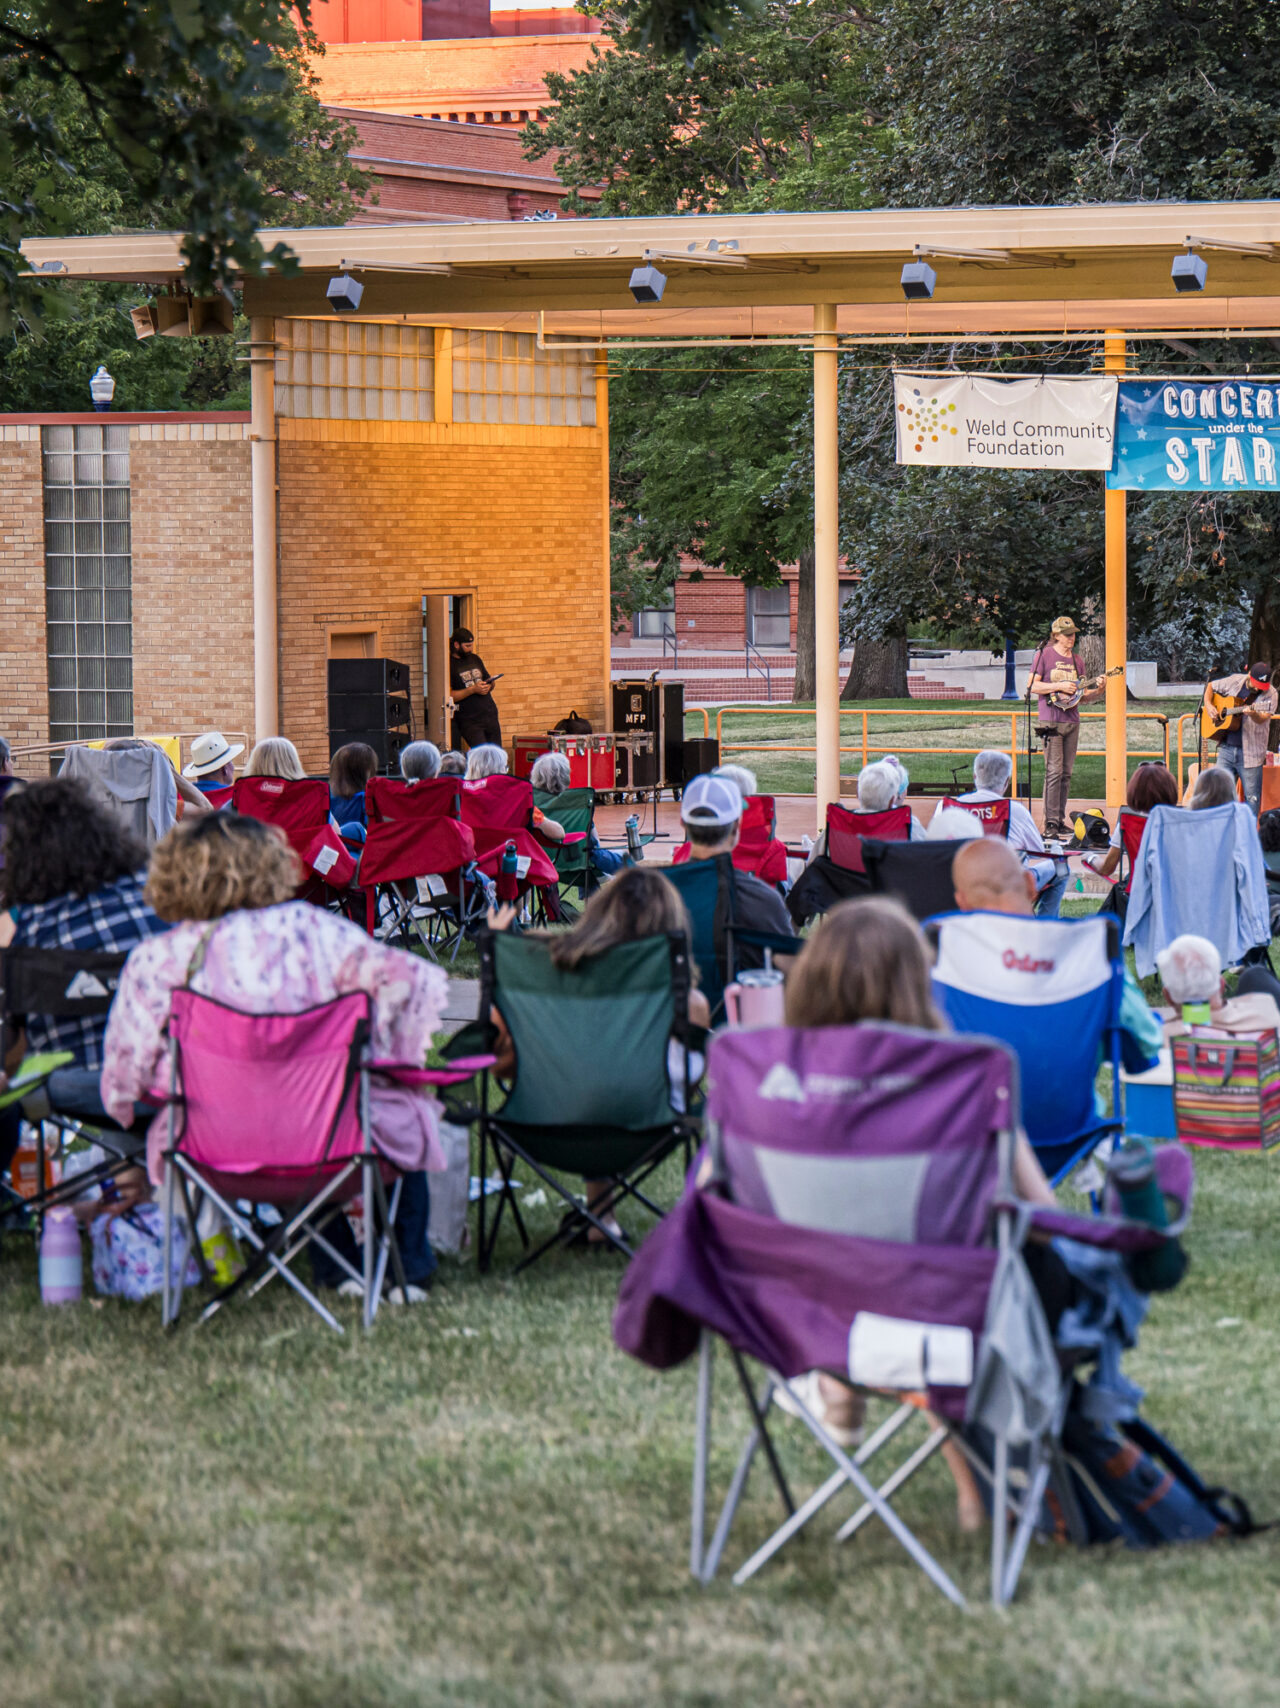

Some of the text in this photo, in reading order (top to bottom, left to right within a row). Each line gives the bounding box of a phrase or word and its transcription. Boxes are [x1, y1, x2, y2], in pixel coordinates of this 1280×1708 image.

[966, 419, 1112, 443] Weld Community
[1208, 423, 1264, 434] under the
[967, 437, 1064, 456] Foundation
[625, 713, 646, 724] MFP
